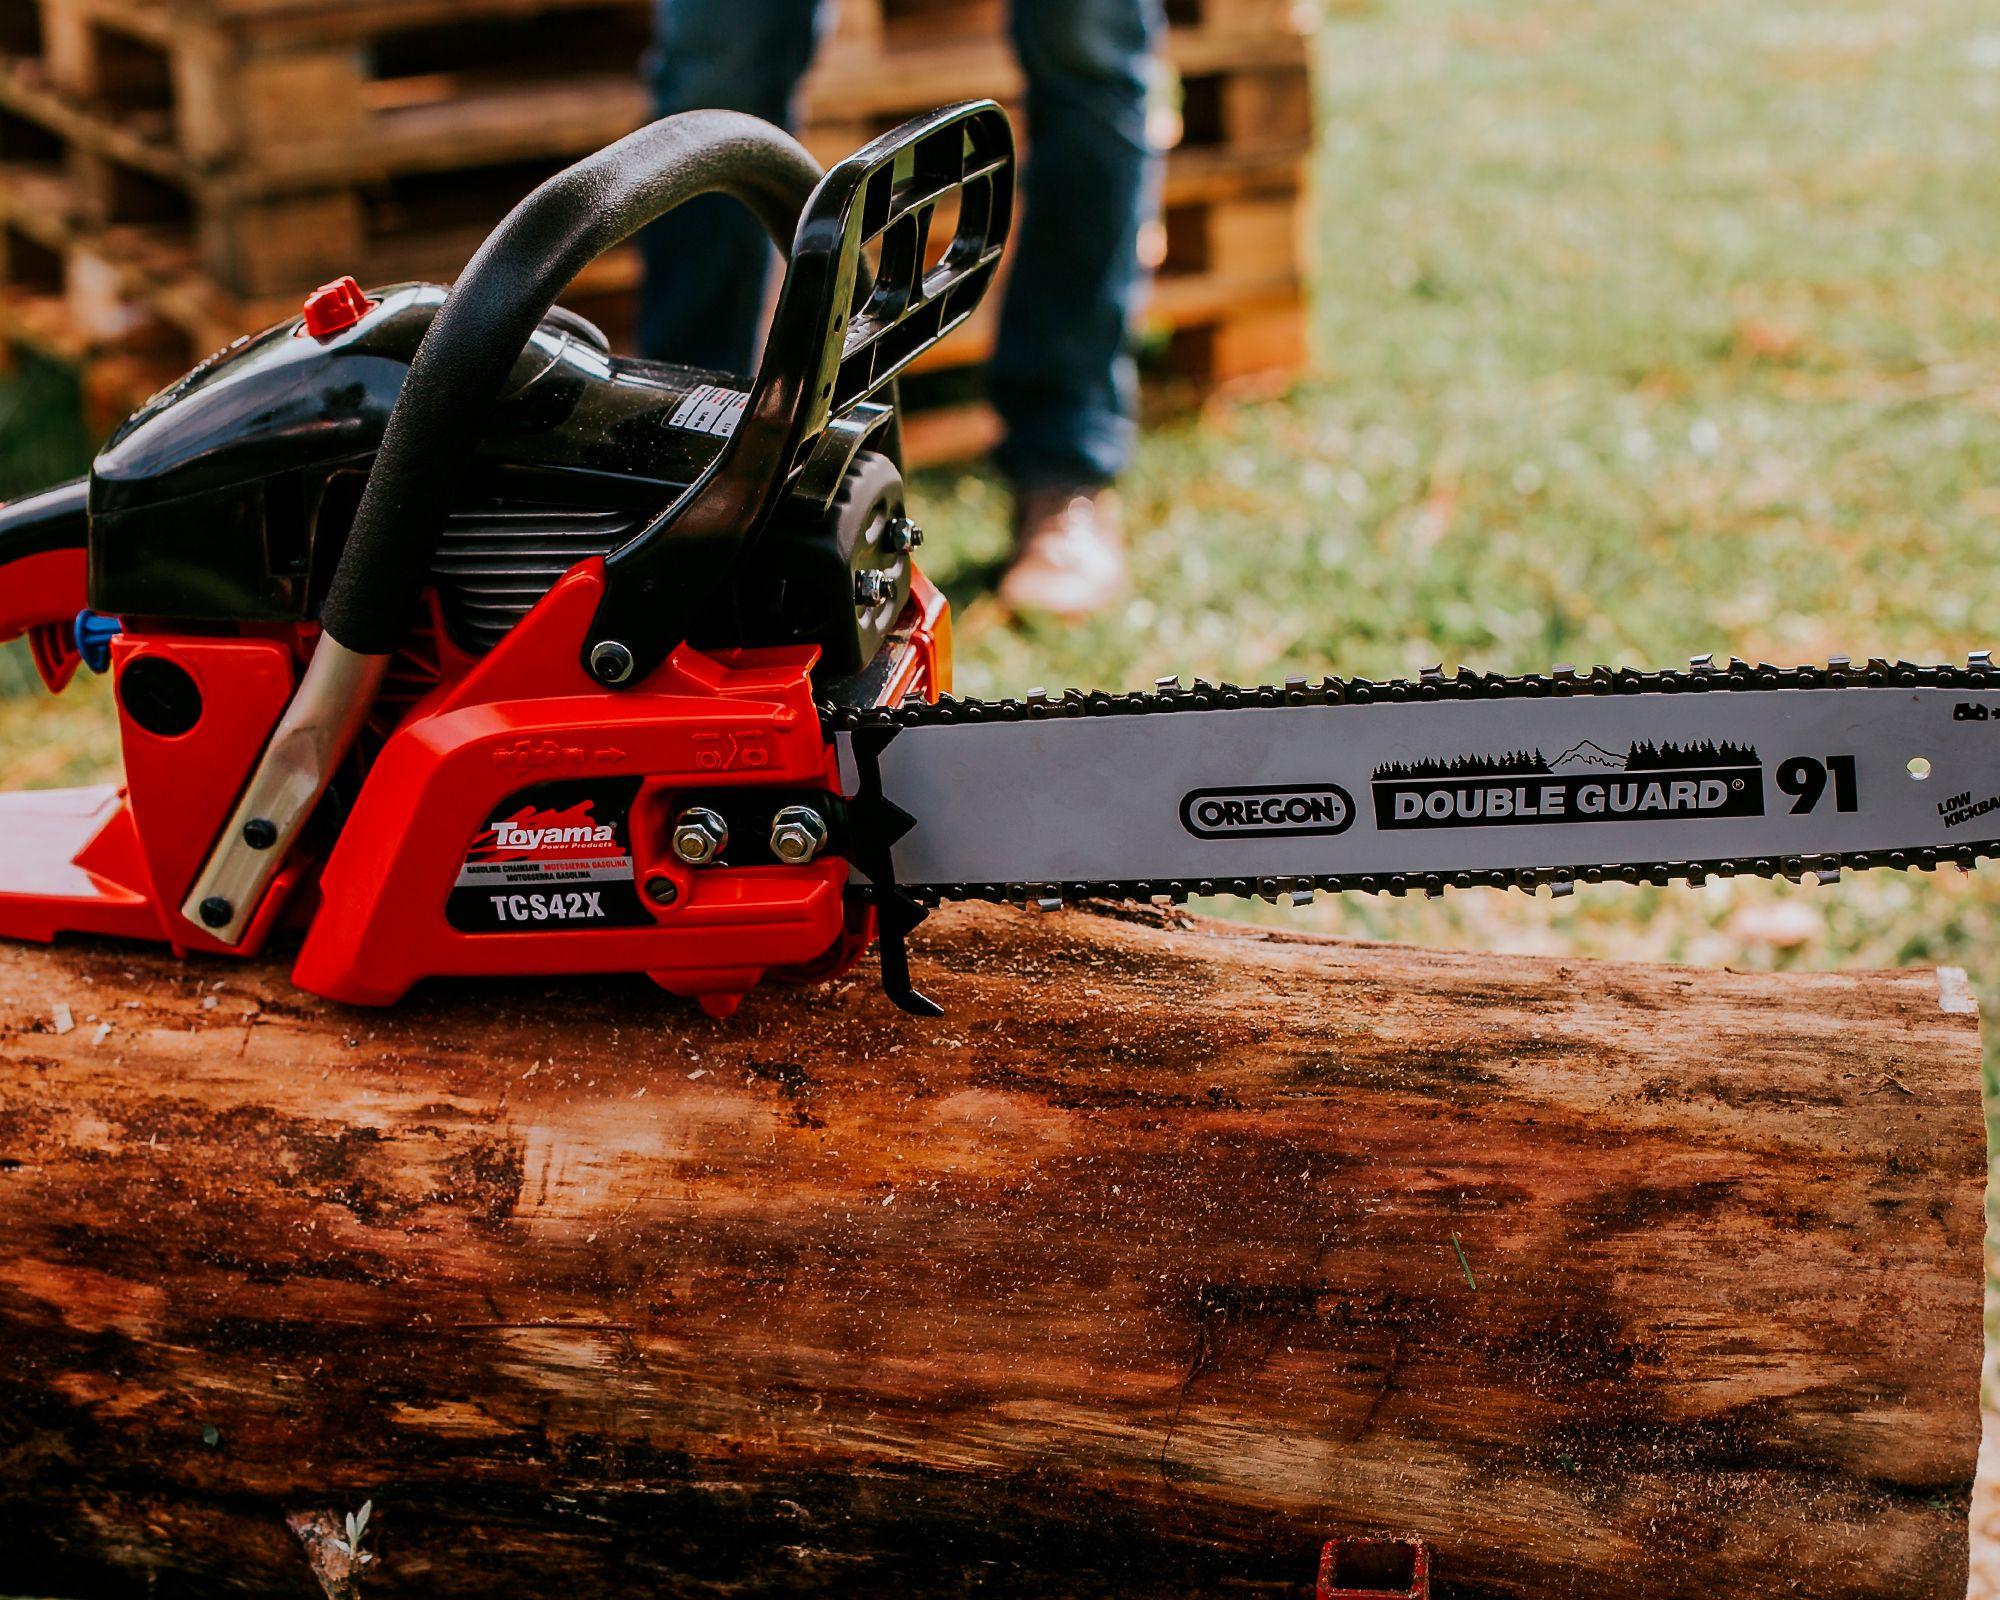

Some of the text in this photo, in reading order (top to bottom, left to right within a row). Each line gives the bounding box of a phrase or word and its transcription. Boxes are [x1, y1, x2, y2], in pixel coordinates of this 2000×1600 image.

[1775, 754, 1858, 816] 91
[1197, 796, 1335, 828] OREGON
[1394, 785, 1567, 820] DOUBLE
[1937, 791, 1971, 815] LOW
[1943, 795, 2000, 829] KICKBA
[490, 891, 605, 921] TCS42X
